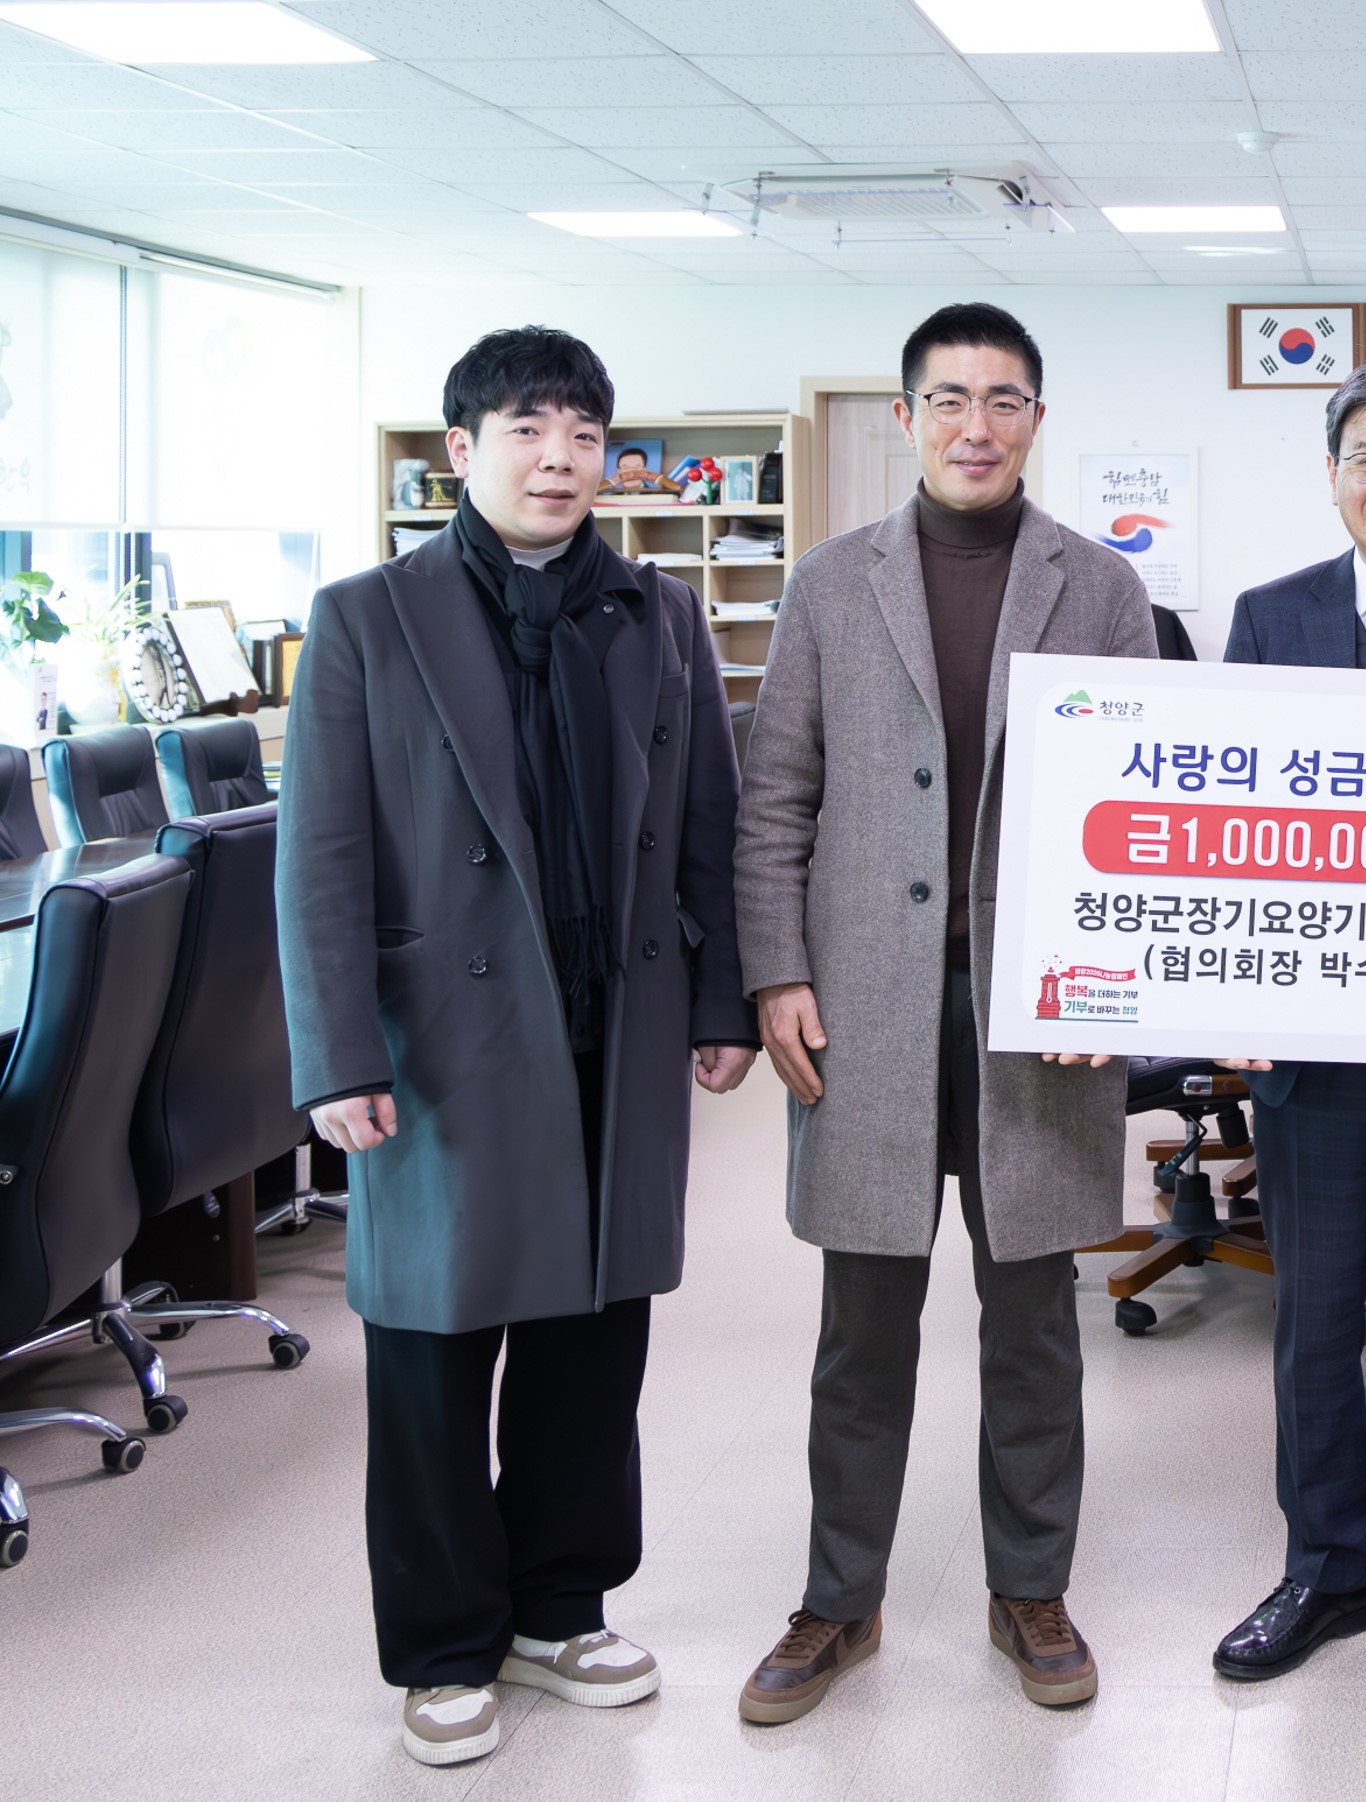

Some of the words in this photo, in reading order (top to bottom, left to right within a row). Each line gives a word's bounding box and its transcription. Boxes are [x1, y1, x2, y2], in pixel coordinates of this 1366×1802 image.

[1099, 701, 1144, 717] 청양군
[1121, 742, 1258, 793] 사랑의
[1143, 943, 1303, 985] (협의회장
[1065, 984, 1095, 997] 행복을
[1098, 990, 1120, 998] 더하는
[1123, 990, 1138, 999] 기부
[1064, 1001, 1095, 1013] 기부로
[1097, 1006, 1120, 1014] 바꾸는
